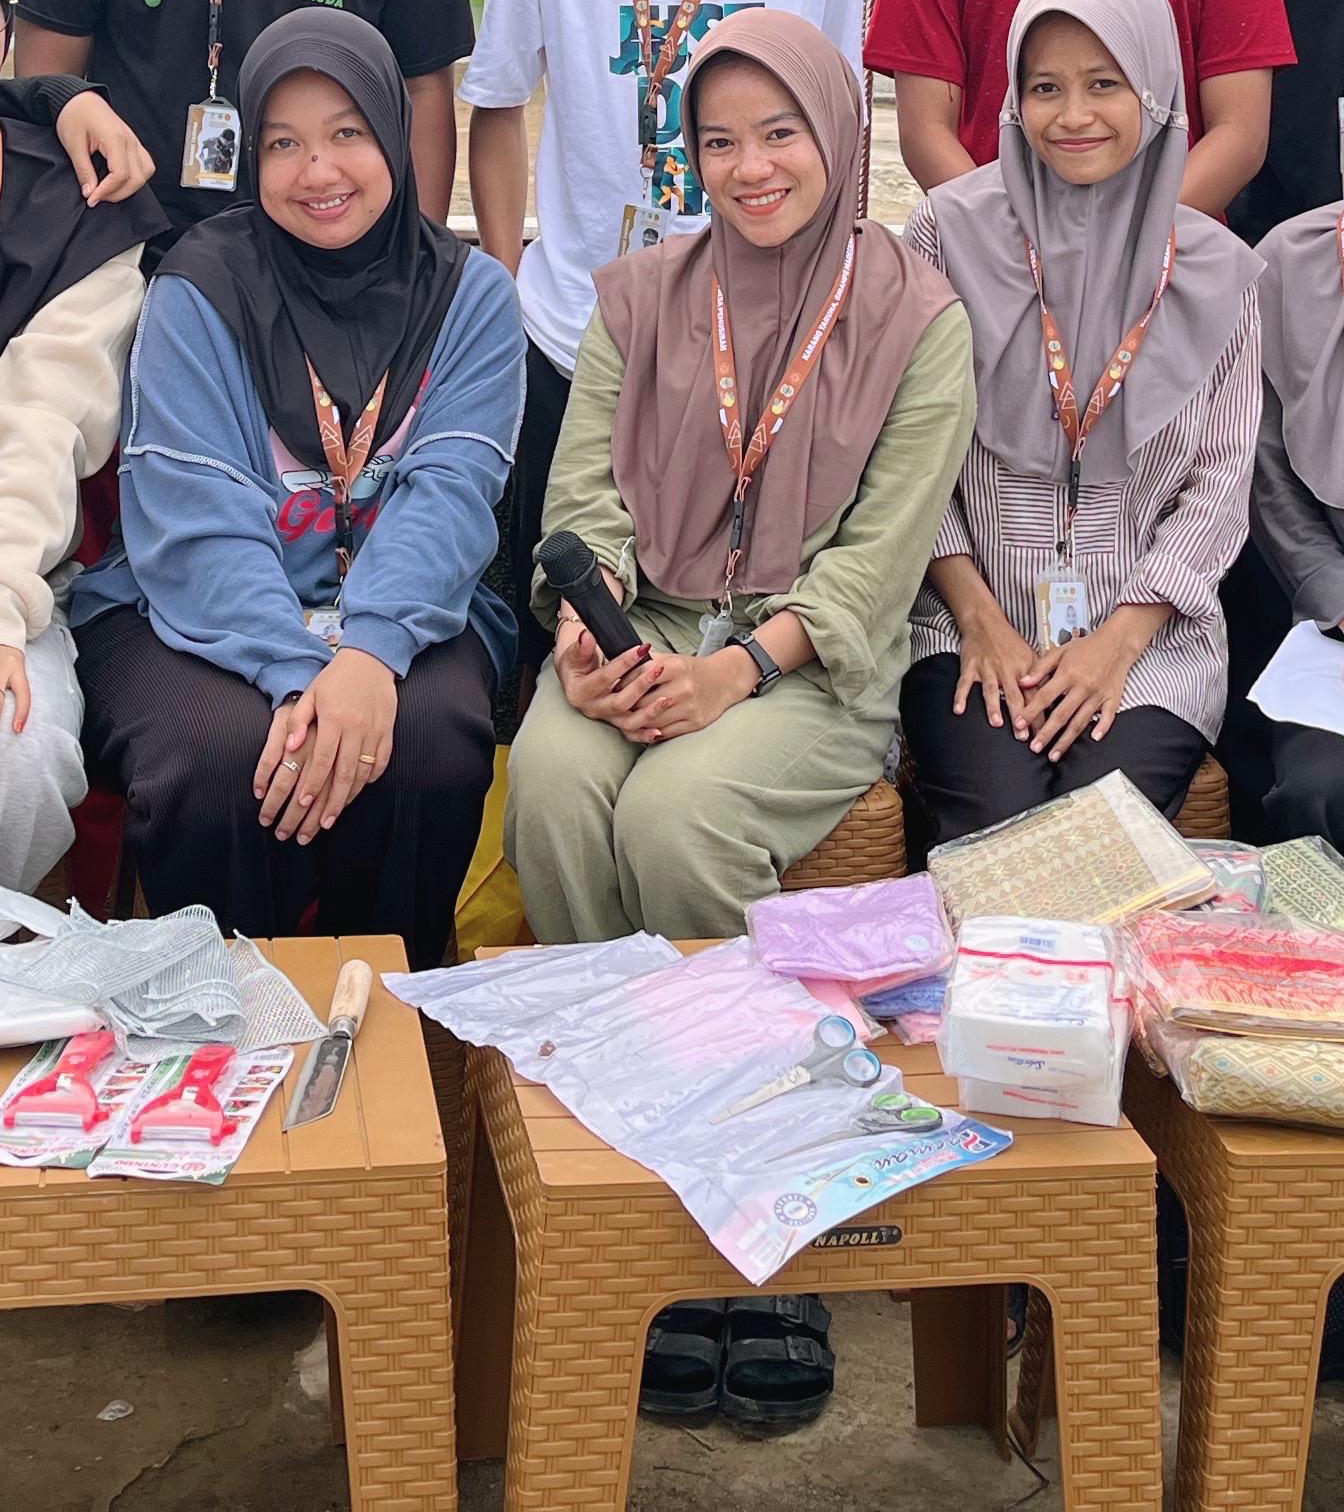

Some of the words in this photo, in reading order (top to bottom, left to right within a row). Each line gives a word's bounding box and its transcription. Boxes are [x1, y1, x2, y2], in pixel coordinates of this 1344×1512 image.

[800, 329, 823, 361] KARANG
[817, 299, 839, 331] TARUNA,
[814, 1226, 890, 1247] NAPOLLY
